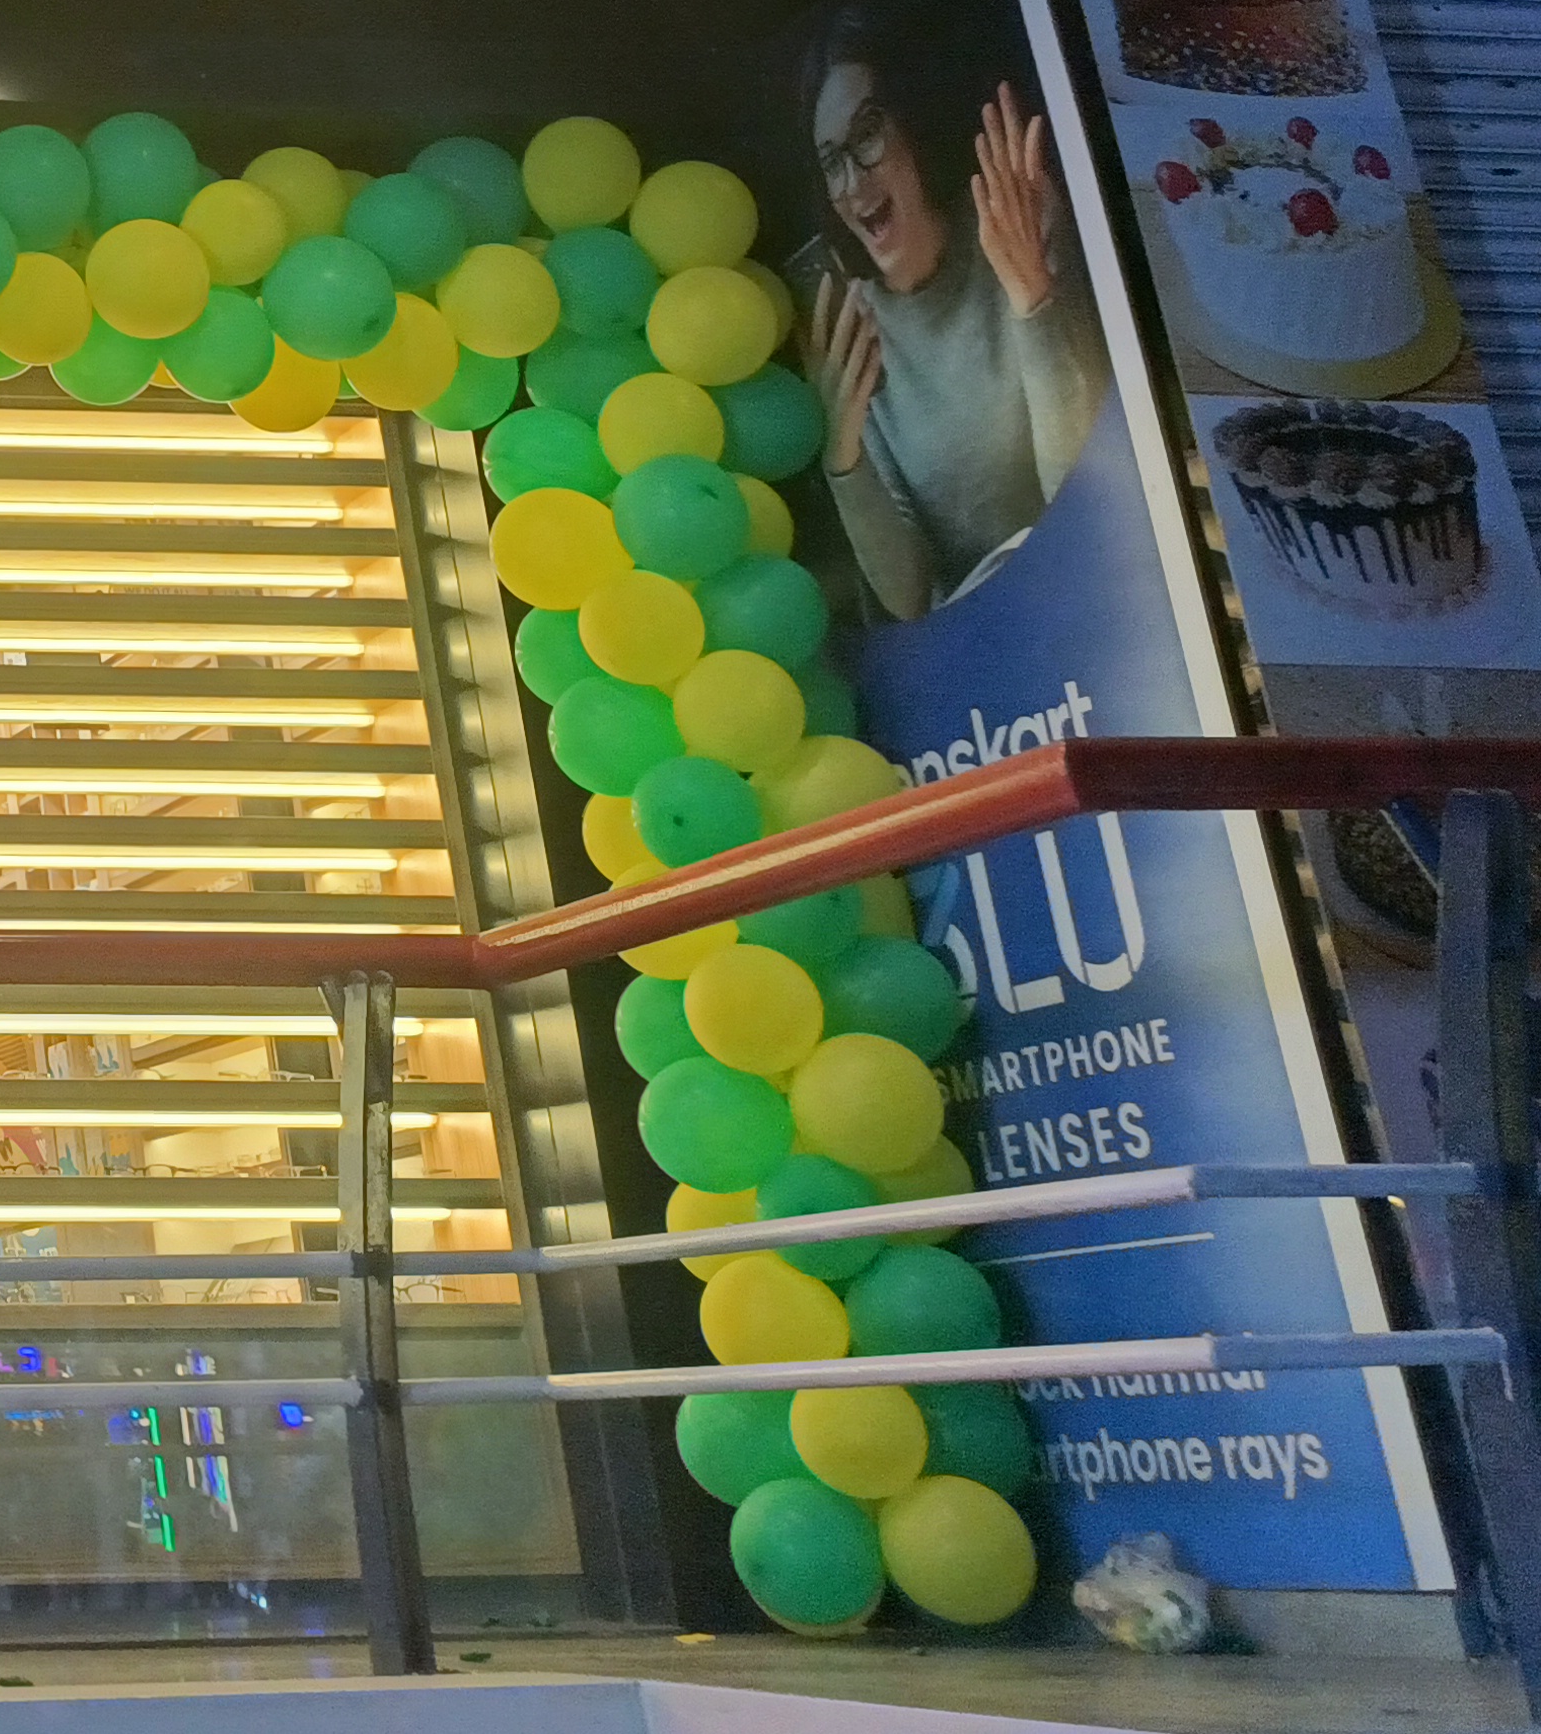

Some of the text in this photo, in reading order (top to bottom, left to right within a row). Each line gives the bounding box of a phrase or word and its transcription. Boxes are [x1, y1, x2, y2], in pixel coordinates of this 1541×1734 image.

[910, 680, 1093, 788] nskart
[932, 1018, 1176, 1106] SMARTPHONE
[977, 1101, 1152, 1184] LENSES
[1047, 1427, 1330, 1502] rtphone rays
